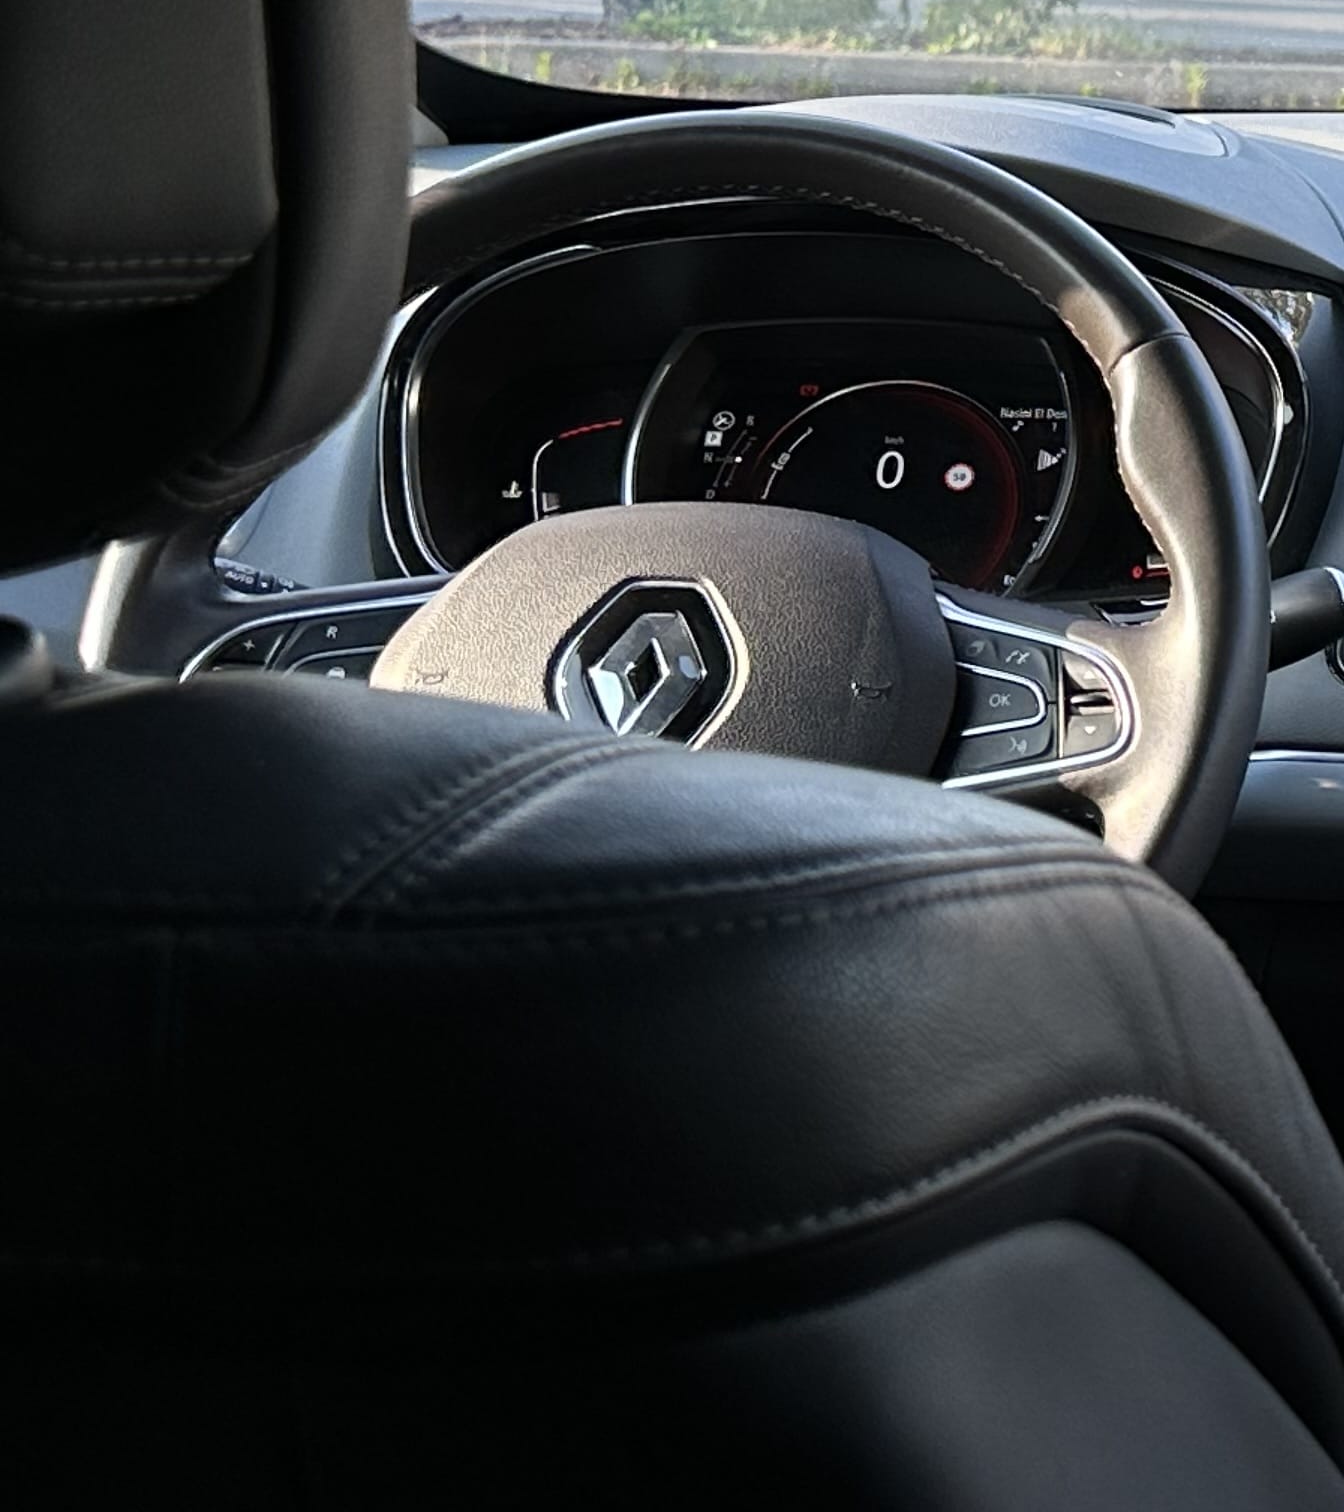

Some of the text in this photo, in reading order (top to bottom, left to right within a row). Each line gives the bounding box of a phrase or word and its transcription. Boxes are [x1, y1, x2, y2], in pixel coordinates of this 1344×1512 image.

[876, 450, 905, 489] 0
[224, 570, 255, 585] AUTO
[326, 625, 339, 639] R
[989, 693, 1012, 707] OK
